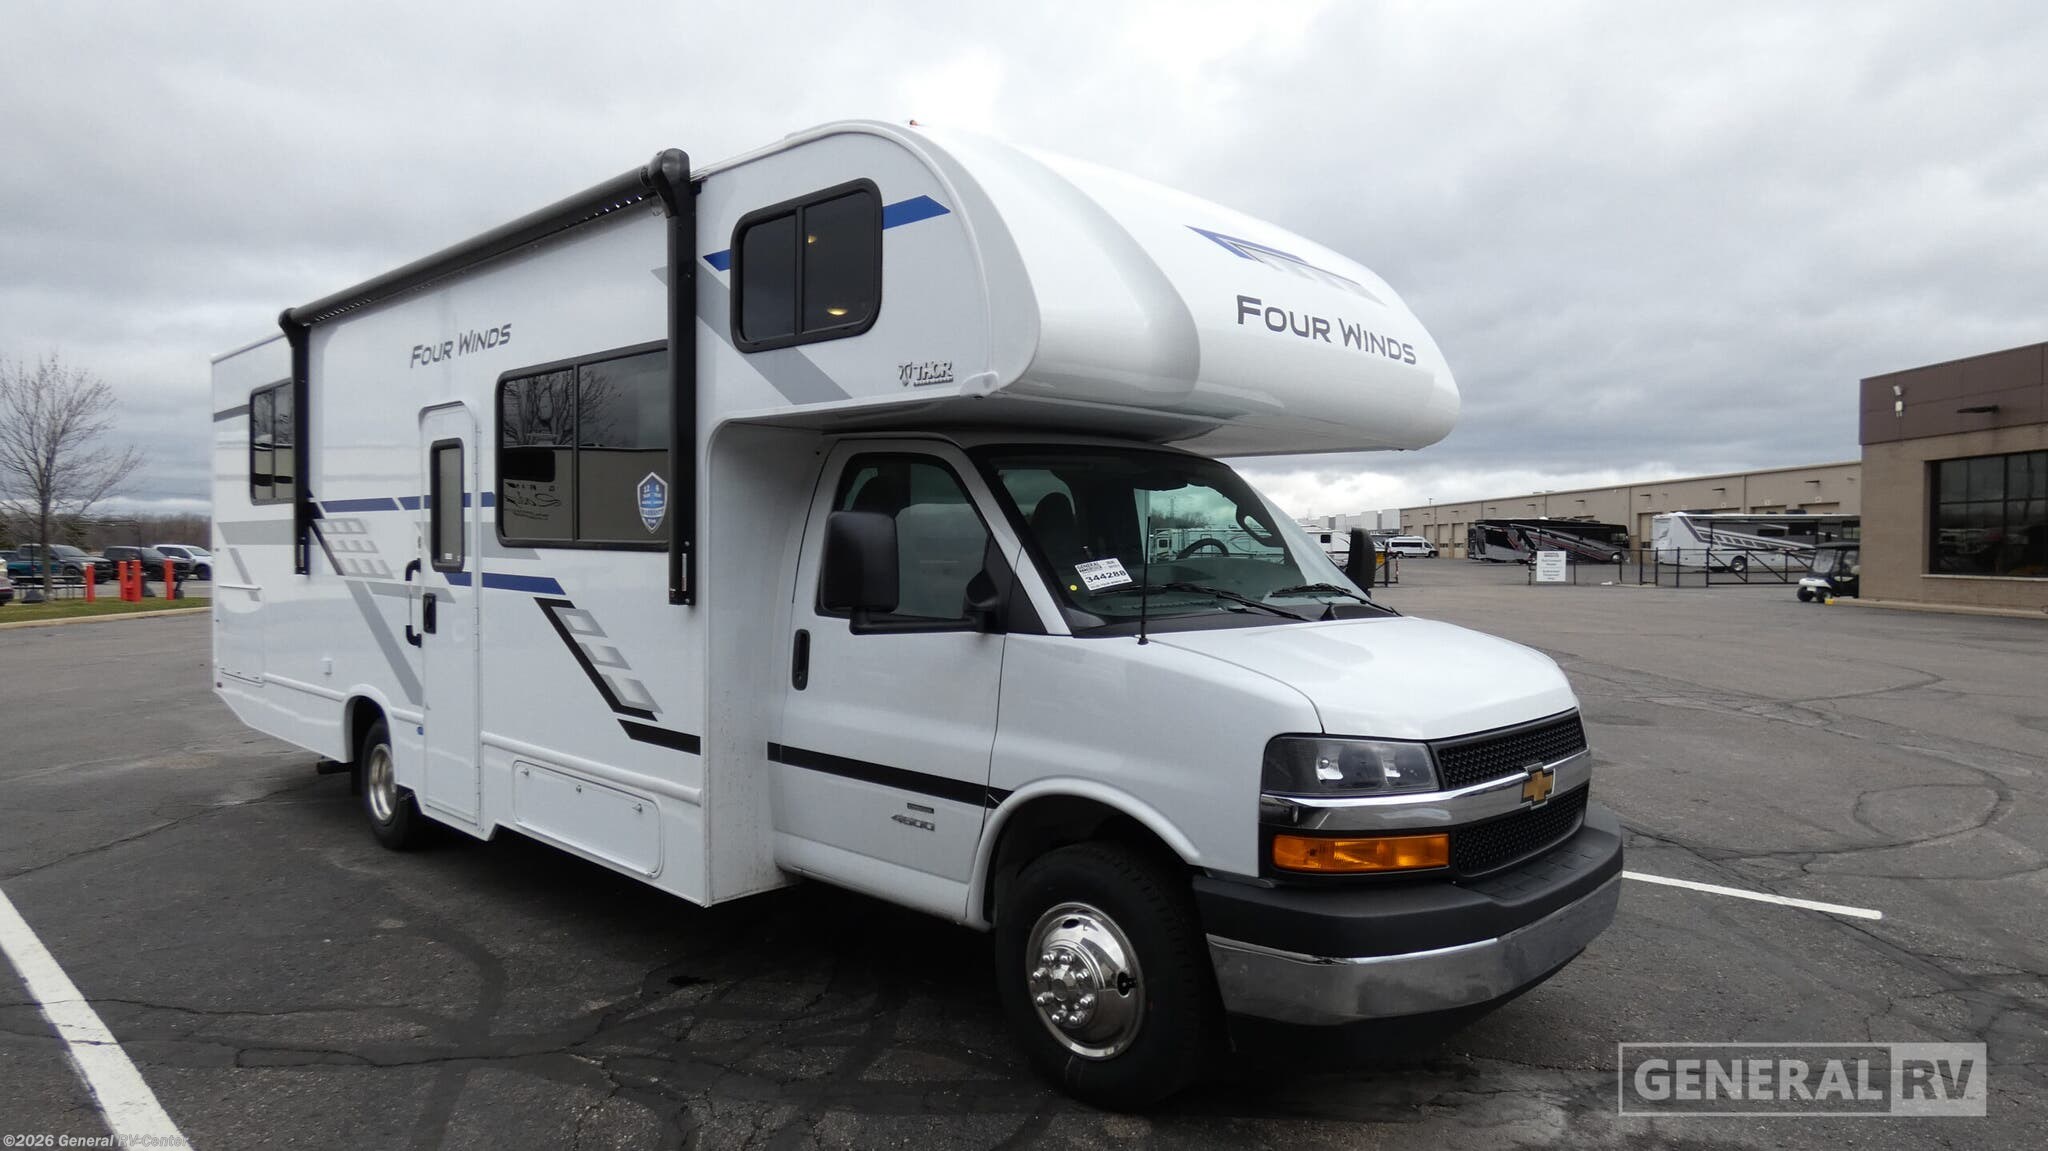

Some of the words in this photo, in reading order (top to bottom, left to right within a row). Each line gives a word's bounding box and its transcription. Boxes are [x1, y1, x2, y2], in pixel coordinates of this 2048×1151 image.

[410, 341, 453, 369] FOUR
[459, 323, 512, 356] WINDS
[1237, 295, 1331, 343] FOUR
[1338, 317, 1416, 365] WINDS
[914, 361, 953, 381] THOR
[1086, 570, 1126, 583] 344288
